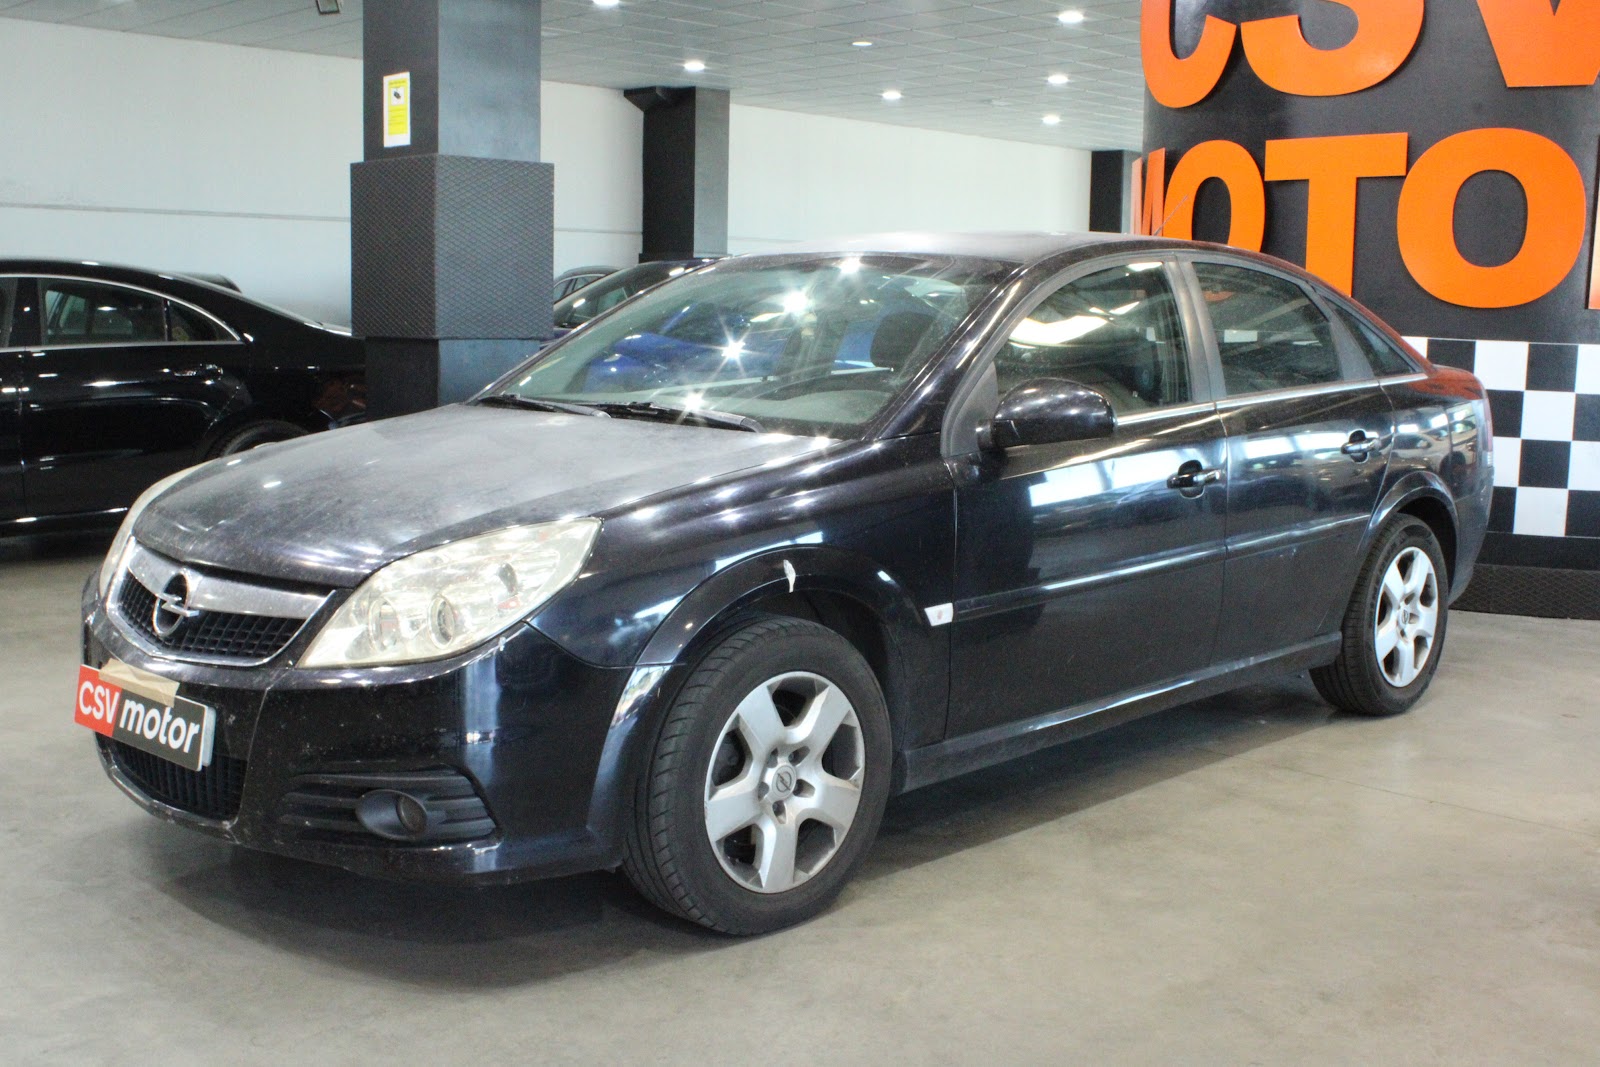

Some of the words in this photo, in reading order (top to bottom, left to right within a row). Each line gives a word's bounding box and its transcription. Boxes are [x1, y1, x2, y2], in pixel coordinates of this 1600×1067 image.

[1131, 127, 1600, 309] MOTO
[79, 681, 120, 724] CSV
[119, 699, 200, 753] motor
